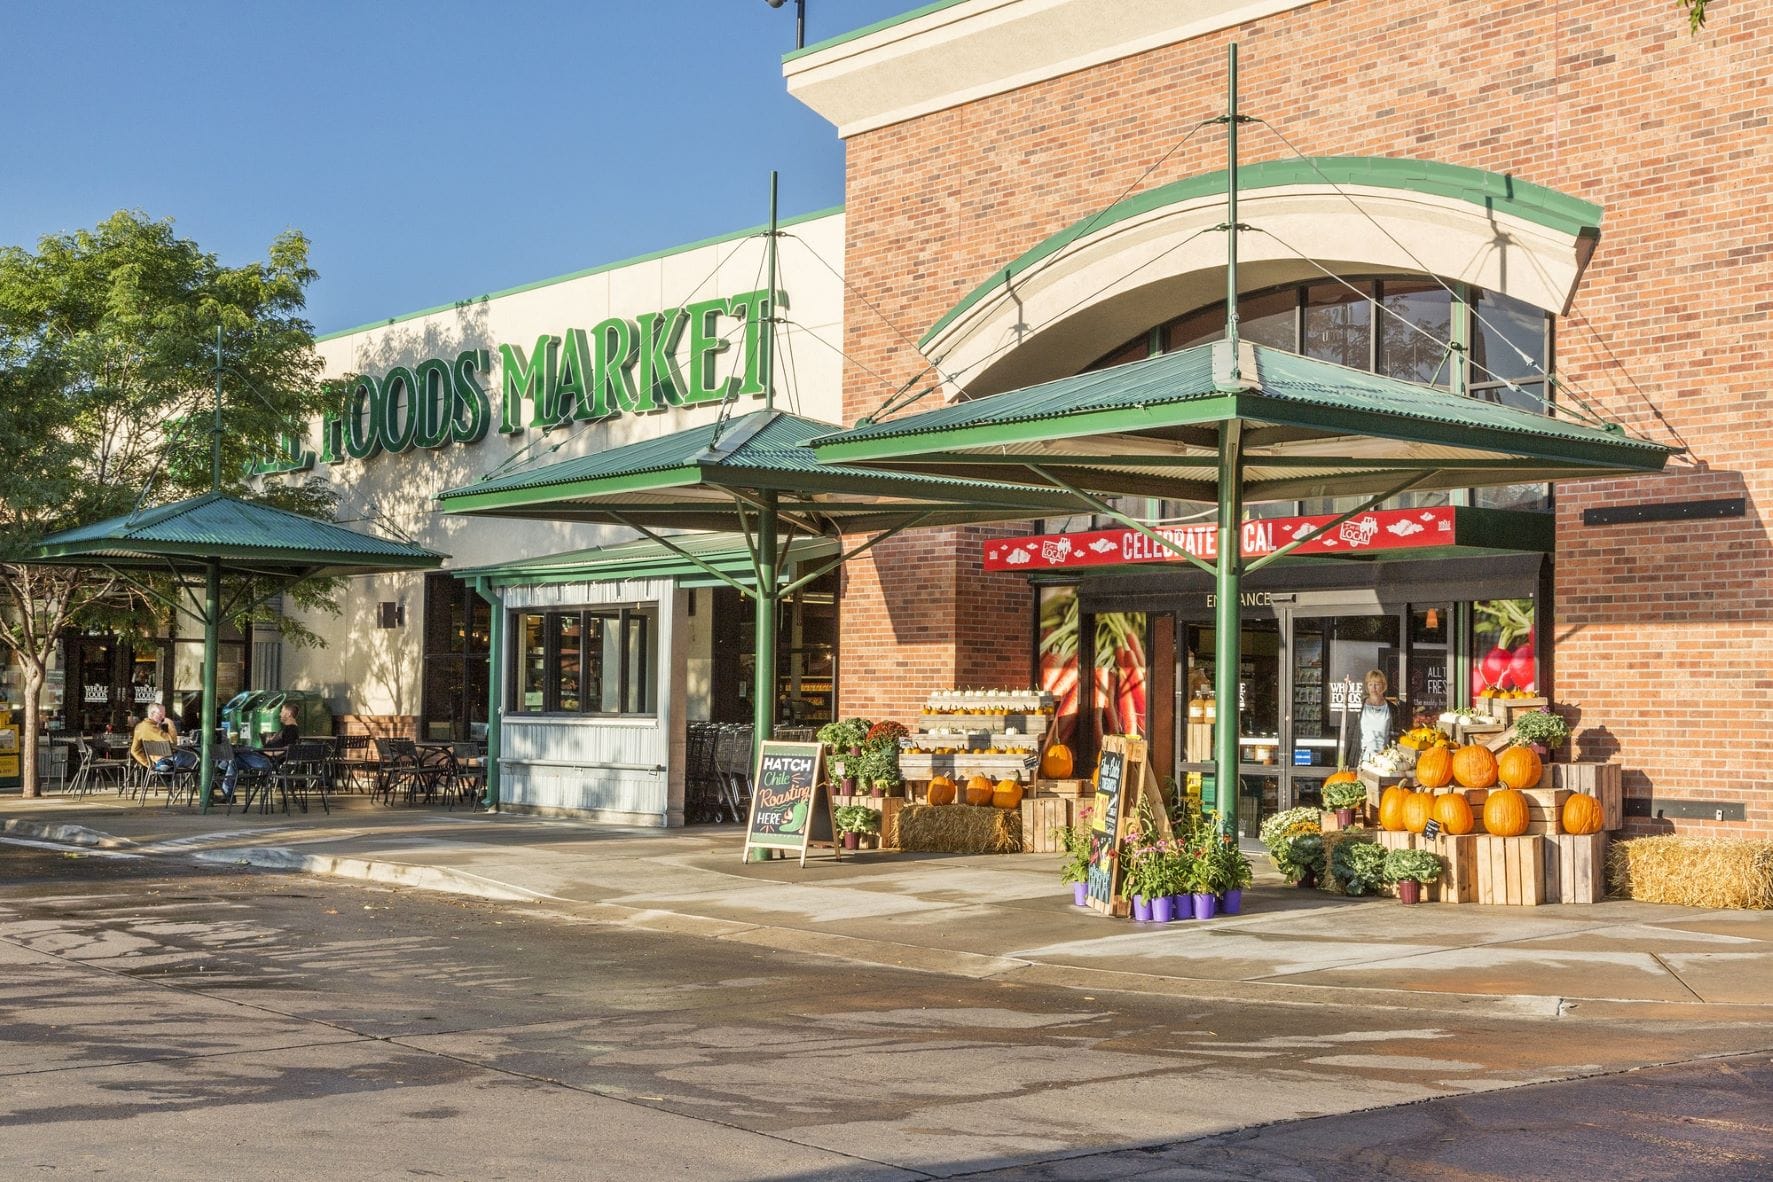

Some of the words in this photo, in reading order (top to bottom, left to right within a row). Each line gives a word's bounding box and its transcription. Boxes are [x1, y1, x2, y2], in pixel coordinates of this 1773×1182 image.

[498, 288, 789, 434] MARKET
[1242, 522, 1278, 553] CAL
[1342, 528, 1368, 541] LOCAL
[1428, 666, 1441, 678] ALL
[1427, 679, 1448, 694] FRES
[763, 758, 811, 771] HATCH
[764, 771, 791, 786] Chile
[759, 784, 811, 809] Roasting
[756, 812, 782, 825] HERE
